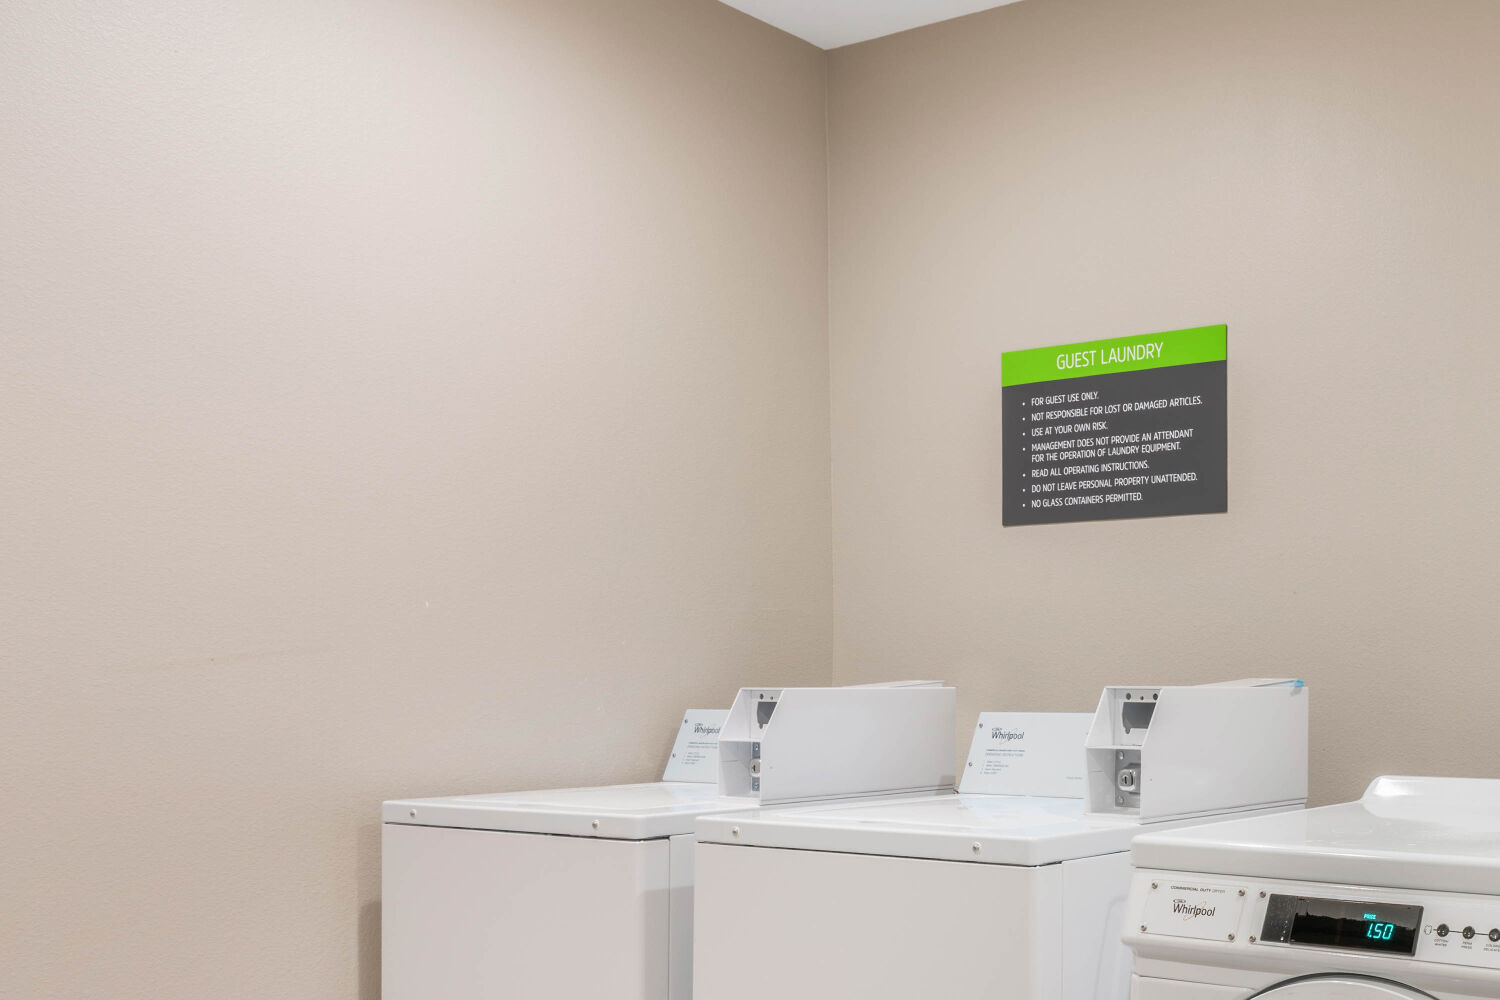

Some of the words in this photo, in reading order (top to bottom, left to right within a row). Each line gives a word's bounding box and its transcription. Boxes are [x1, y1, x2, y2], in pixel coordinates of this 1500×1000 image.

[1056, 350, 1097, 370] GUEST
[1101, 342, 1164, 365] LAUNDRY
[1031, 397, 1044, 406] FOR
[1045, 394, 1066, 405] GUEST
[1067, 393, 1080, 403] USE
[1081, 391, 1099, 401] ONLY.
[1031, 412, 1044, 421] NOT
[1046, 407, 1088, 420] RESPONSIBLE
[1089, 406, 1103, 417] FOR
[1104, 403, 1121, 414] LOST
[1122, 403, 1133, 412] OR
[1134, 399, 1168, 411] DAMAGED
[1169, 395, 1203, 408] ARTICLES.
[1031, 427, 1043, 437] USE
[1044, 426, 1053, 435] AT
[1054, 424, 1072, 434] YOUR
[1073, 423, 1091, 433] OWN
[1092, 421, 1108, 430] RISK.
[1031, 439, 1076, 452] MANAGEMENT
[1076, 438, 1094, 447] DOES
[1095, 436, 1109, 446] NOT
[1110, 433, 1140, 445] PROVIDE
[1141, 432, 1152, 442] AN
[1153, 428, 1194, 441] ATTENDANT
[1031, 453, 1044, 463] FOR
[1046, 452, 1058, 461] THE
[1059, 449, 1096, 460] OPERATION
[1097, 447, 1106, 457] OF
[1107, 445, 1140, 456] LAUNDRY
[1141, 441, 1181, 454] EQUIPMENT.
[1031, 468, 1049, 478] READ
[1050, 467, 1062, 477] ALL
[1063, 464, 1100, 476] OPERATING
[1100, 460, 1149, 472] INSTRUCTIONS.
[1031, 484, 1041, 493] DO
[1042, 482, 1056, 492] NOT
[1057, 481, 1077, 491] LEAVE
[1078, 479, 1112, 490] PERSONAL
[1114, 475, 1150, 487] PROPERTY
[1150, 472, 1198, 484] UNATTENDED.
[1031, 499, 1041, 508] NO
[1042, 497, 1063, 508] GLASS
[1064, 494, 1104, 506] CONTAINERS
[1105, 491, 1143, 503] PERMITTED.
[992, 732, 1024, 740] Whirlpool
[1173, 903, 1216, 918] Whirlpool
[1367, 922, 1394, 940] 1.50
